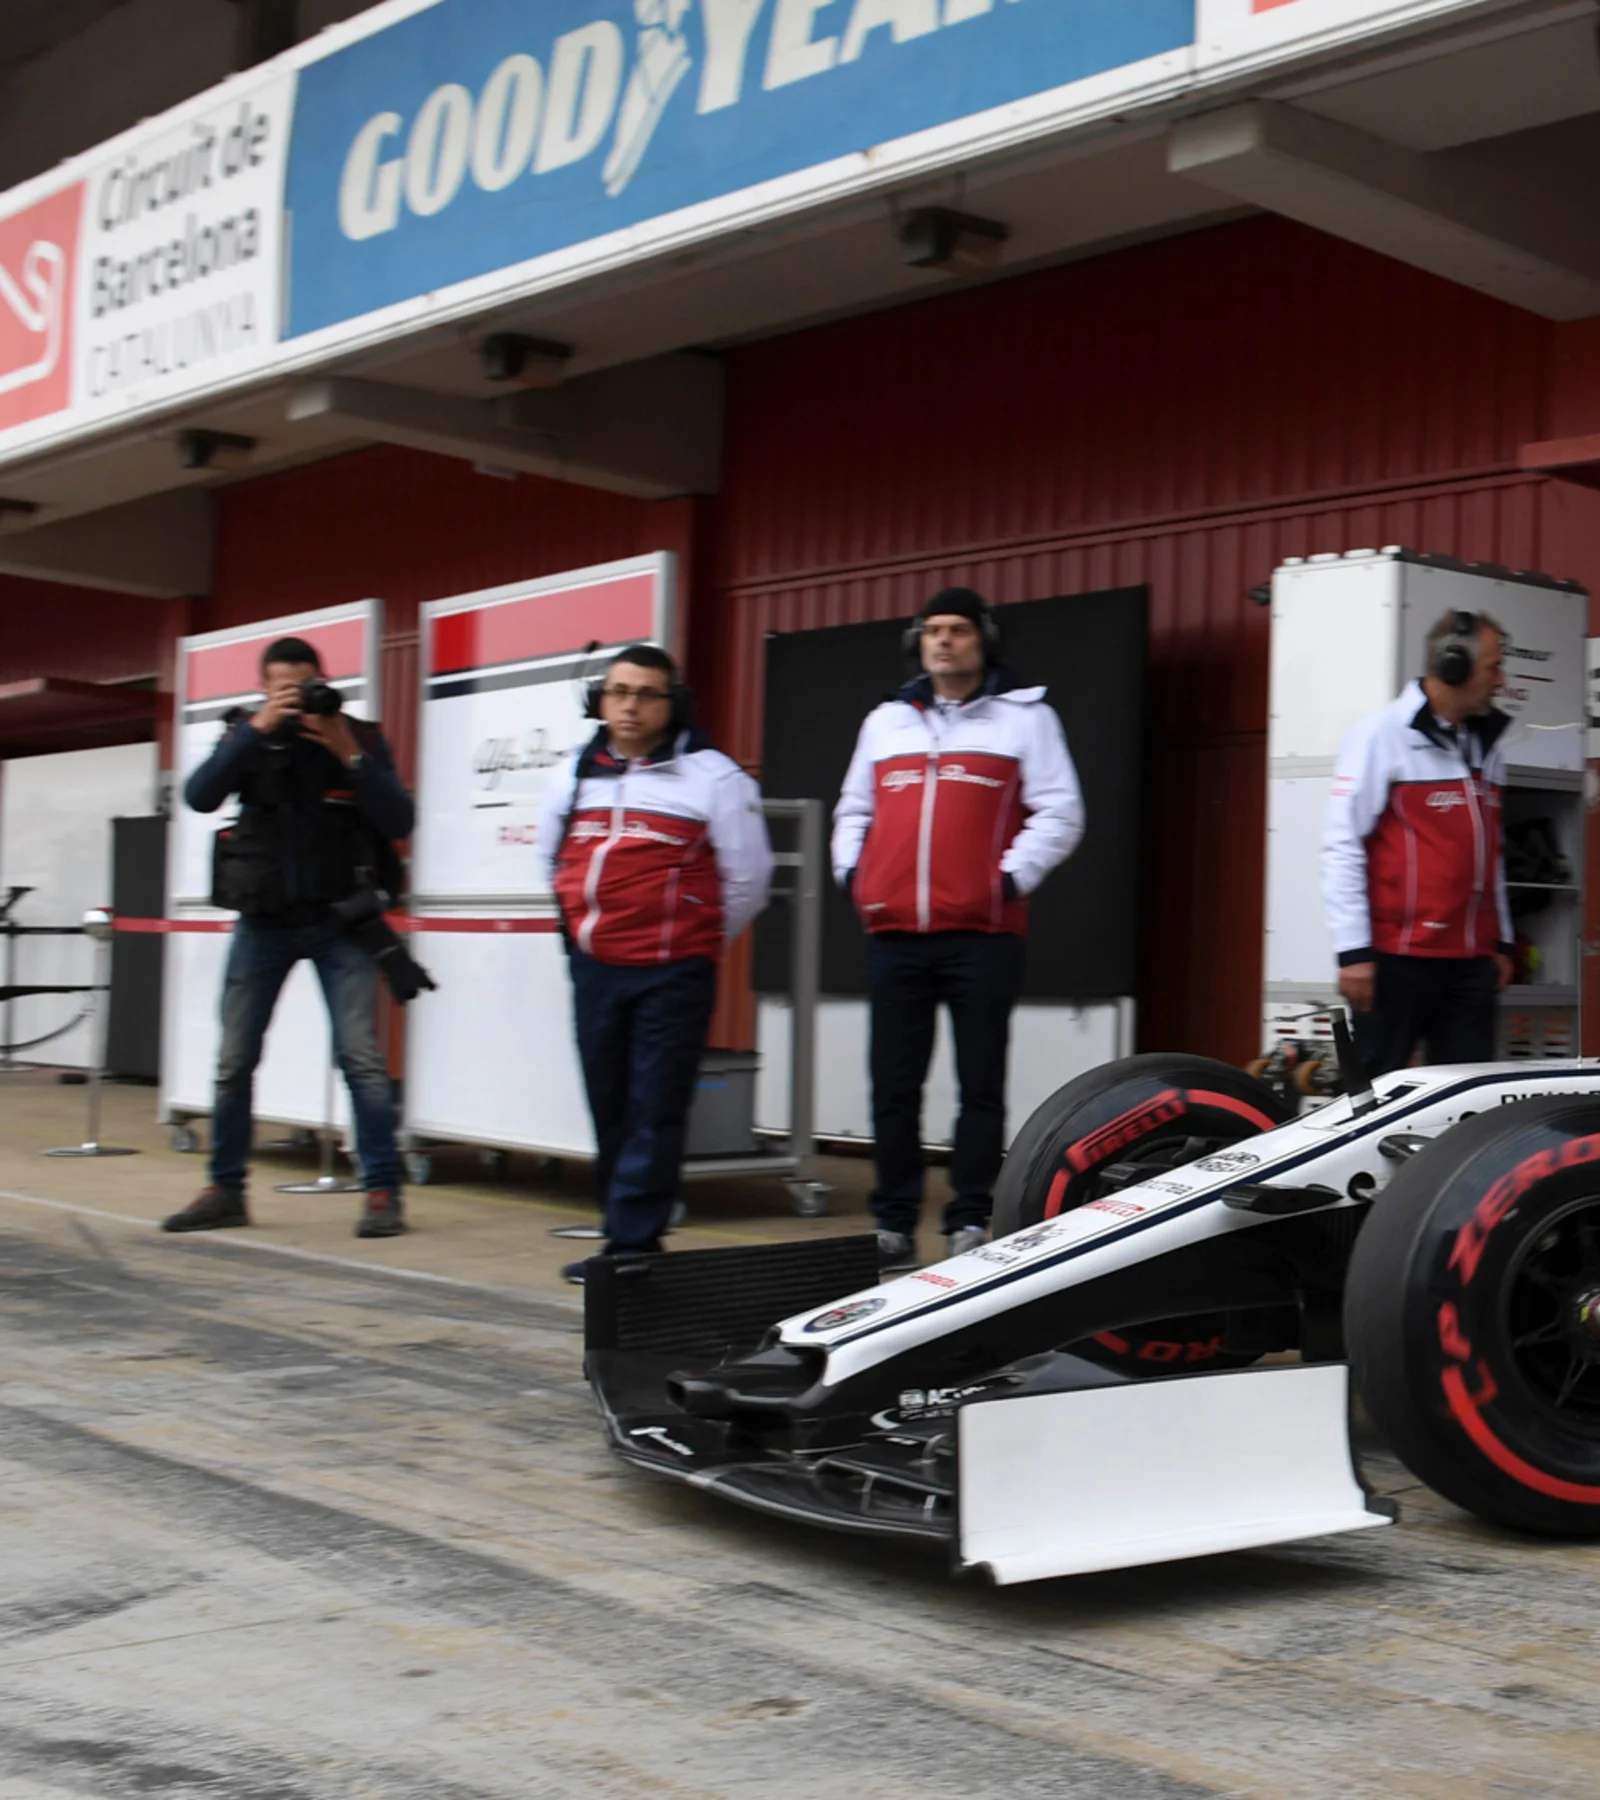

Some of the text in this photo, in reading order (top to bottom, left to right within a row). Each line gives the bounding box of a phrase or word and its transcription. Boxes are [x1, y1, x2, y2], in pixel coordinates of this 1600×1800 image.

[99, 101, 270, 232] Circuit de
[338, 0, 996, 241] GOODYEA
[92, 209, 259, 319] Barcelona
[87, 292, 259, 398] CATALUNYA
